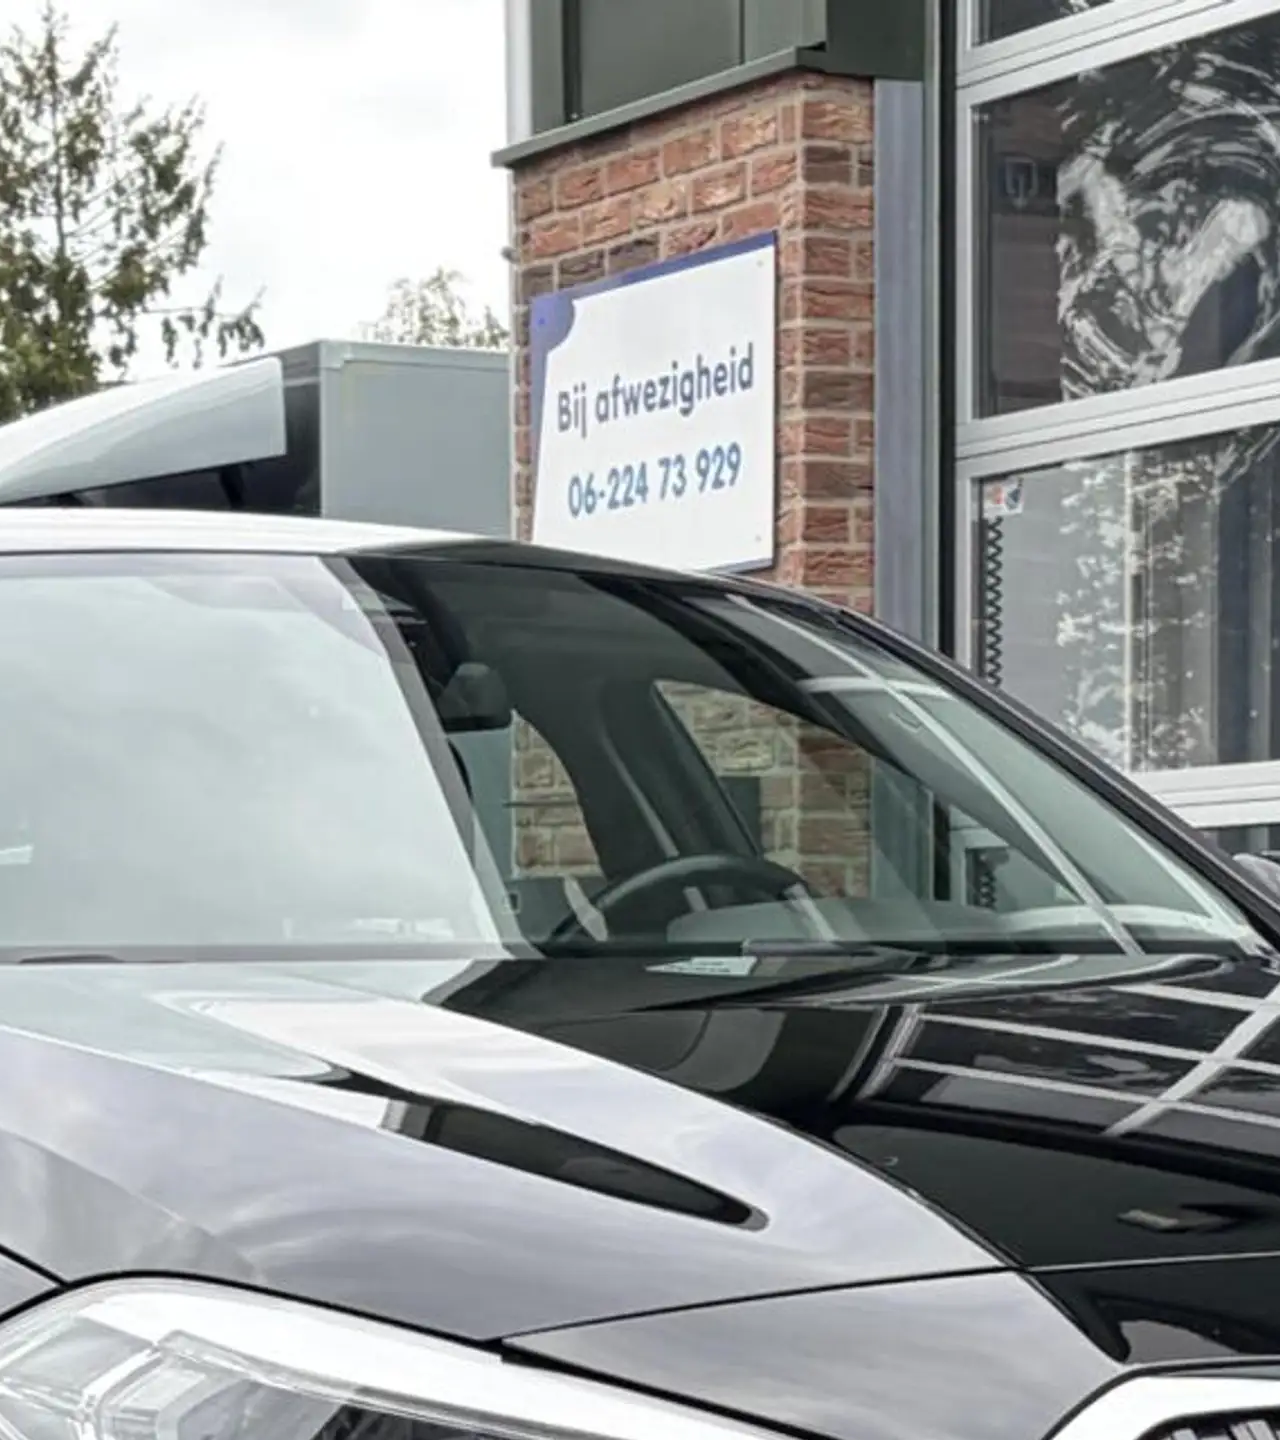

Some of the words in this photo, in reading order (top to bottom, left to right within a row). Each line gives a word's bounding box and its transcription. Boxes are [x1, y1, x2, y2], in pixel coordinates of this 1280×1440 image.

[557, 382, 587, 439] Bij
[594, 342, 754, 423] afwezigheid
[569, 462, 649, 518] 06-224
[658, 453, 688, 501] 73
[695, 441, 742, 494] 929
